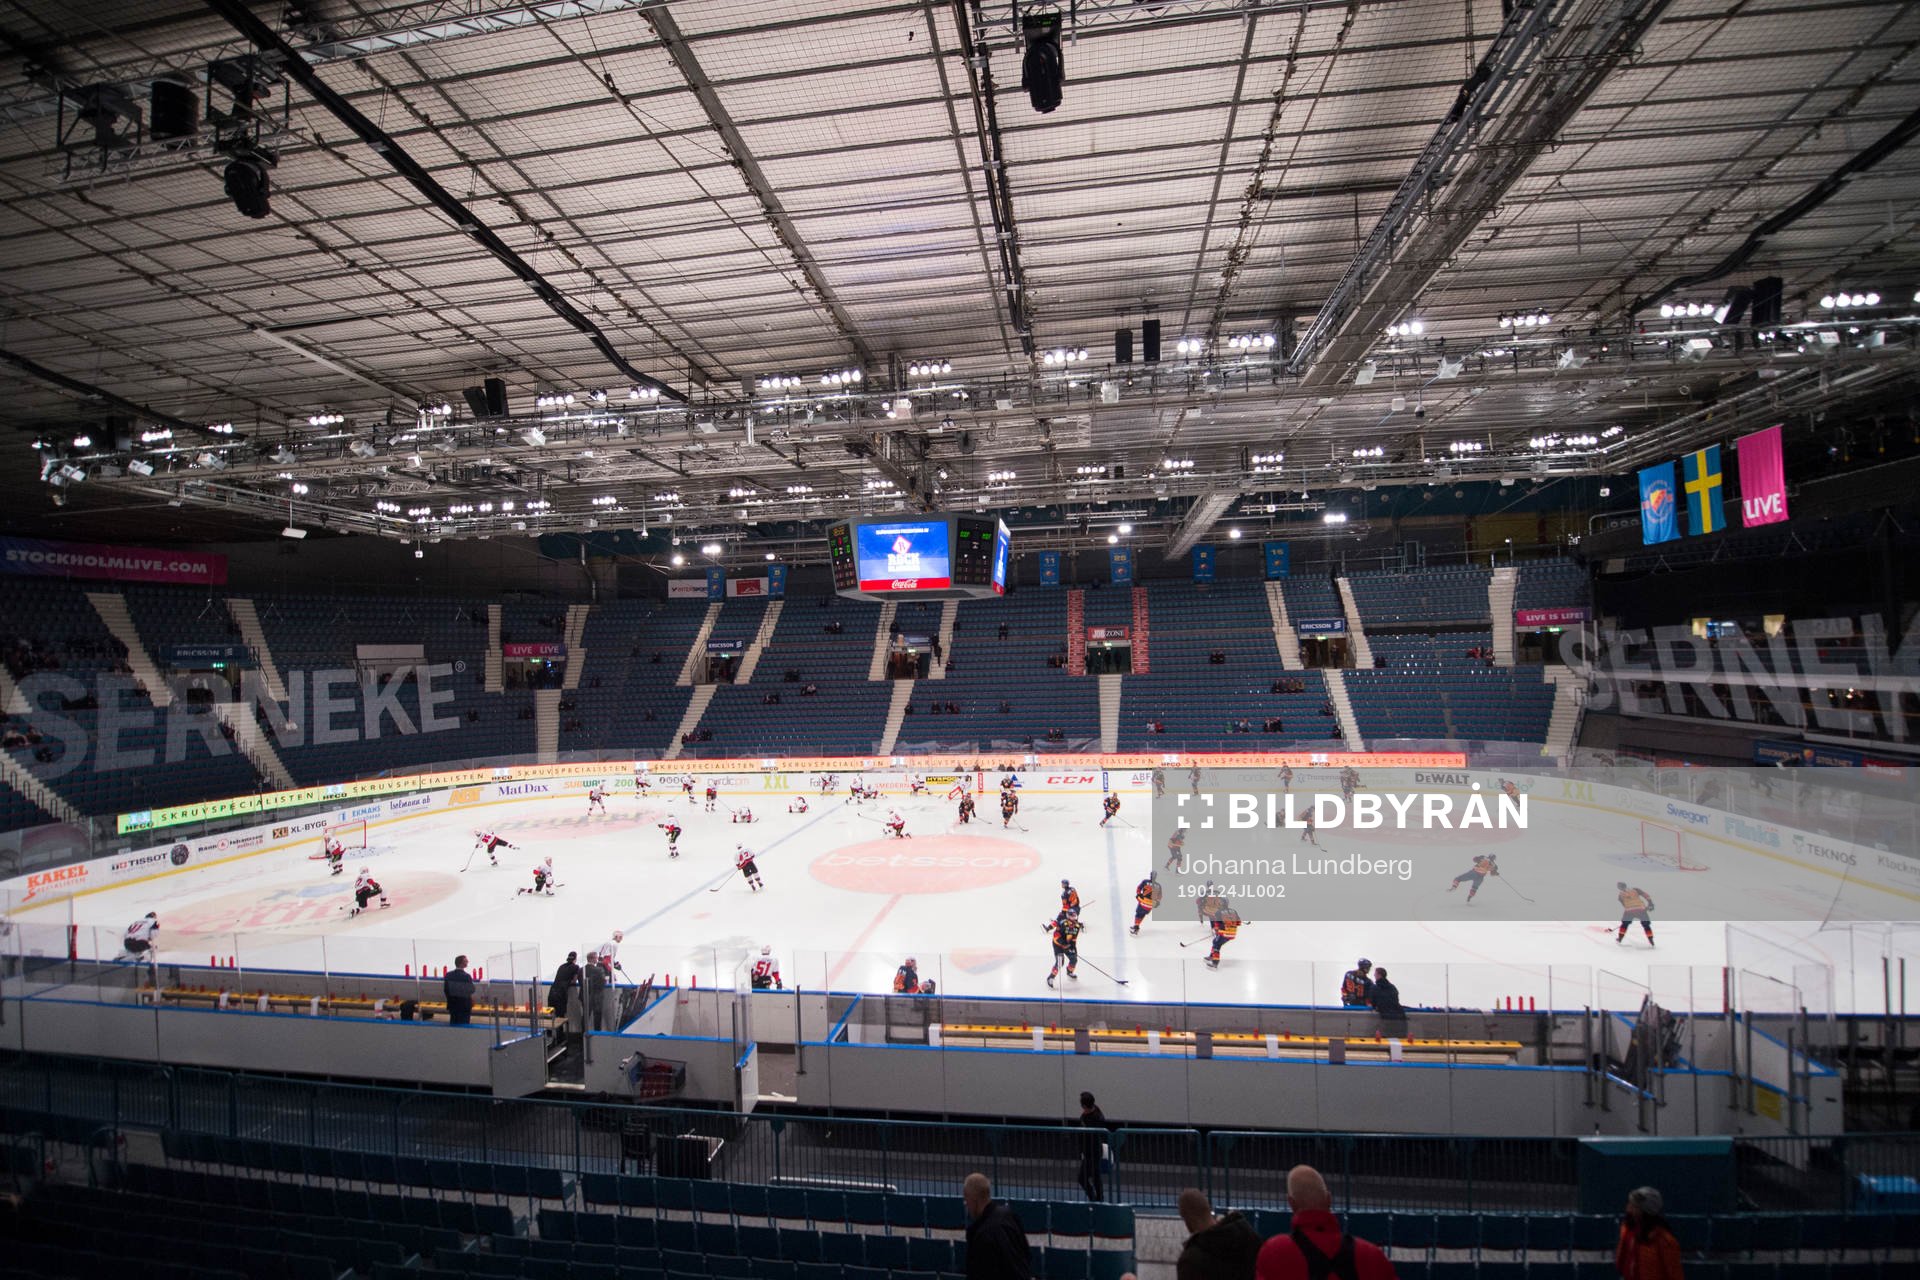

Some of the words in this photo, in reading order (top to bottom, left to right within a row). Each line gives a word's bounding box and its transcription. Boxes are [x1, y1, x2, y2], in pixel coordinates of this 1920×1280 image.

[1743, 493, 1783, 519] LIVE
[5, 548, 208, 575] STOCKHOLMLIVE.COM
[1526, 613, 1547, 622] LIVE
[176, 649, 220, 657] ERICSSON
[513, 645, 533, 655] LIVE
[540, 645, 560, 655] LIVE
[9, 663, 461, 780] SERNEKE
[517, 765, 627, 777] SKRUVSPECIALISTEN
[1047, 776, 1094, 784] CCM
[353, 772, 484, 793] SKRUVSPECIALISTEN
[763, 775, 789, 789] XXL
[1562, 780, 1596, 802] XXL
[161, 791, 314, 822] SKRUVSPECIALISTEN
[1667, 803, 1708, 824] Swegon
[290, 820, 328, 834] XL-BYGG
[128, 852, 168, 867] TISSOT
[820, 853, 1033, 868] betsson
[1806, 843, 1857, 866] TEKNOS
[27, 864, 89, 889] KAKEL
